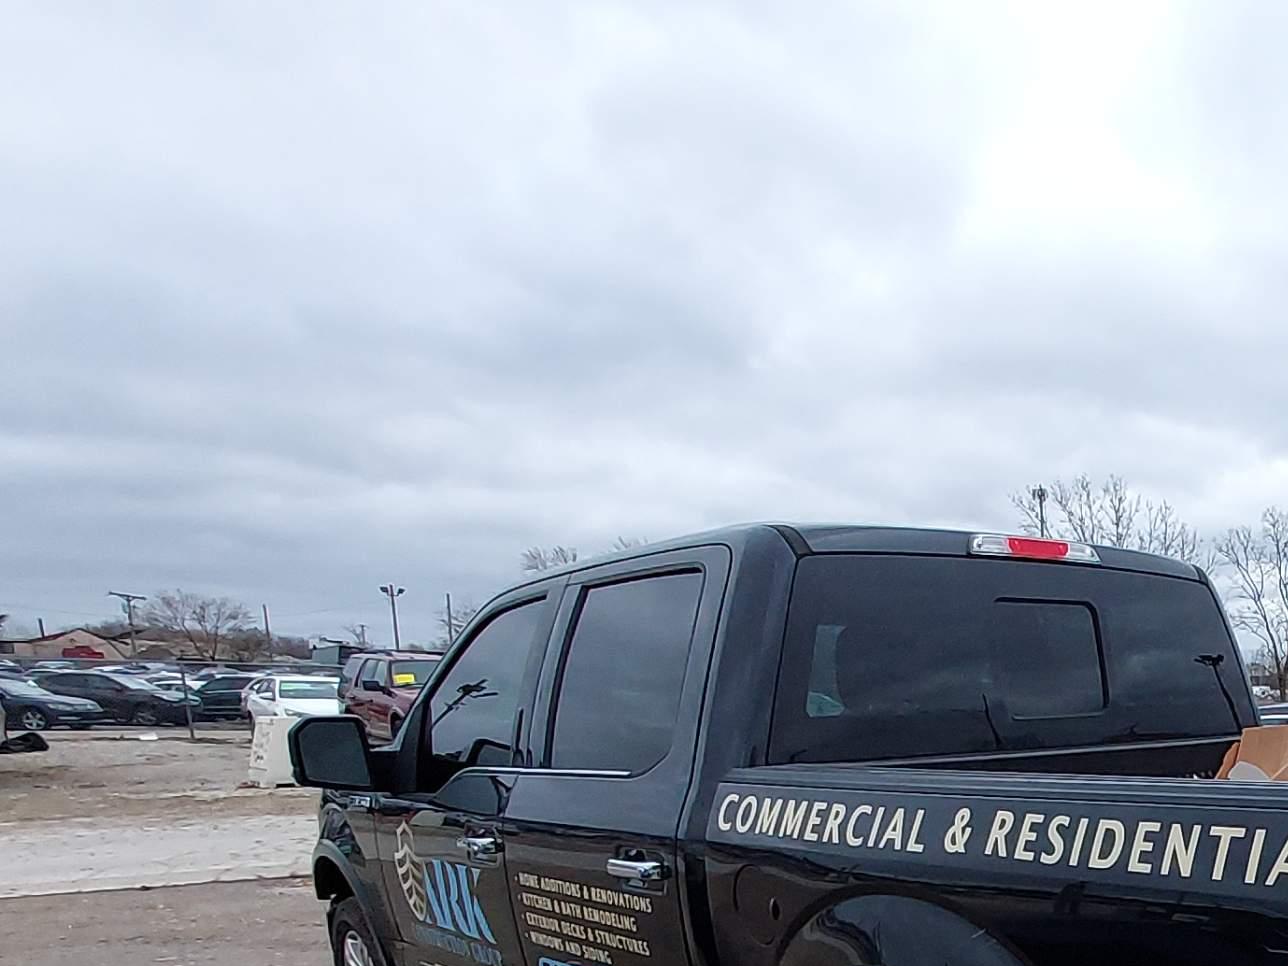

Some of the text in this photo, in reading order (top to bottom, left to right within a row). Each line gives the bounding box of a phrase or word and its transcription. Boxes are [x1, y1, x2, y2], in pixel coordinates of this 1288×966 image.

[716, 792, 927, 853] COMMERCIAL
[944, 807, 974, 855] &
[421, 858, 498, 945] ARK
[590, 887, 652, 913] RENOVATIONS
[583, 906, 637, 932] REMODELING
[560, 941, 582, 956] AND
[581, 945, 612, 965] SIDING
[561, 921, 587, 940] DECKS
[594, 929, 651, 956] STRUCTURES
